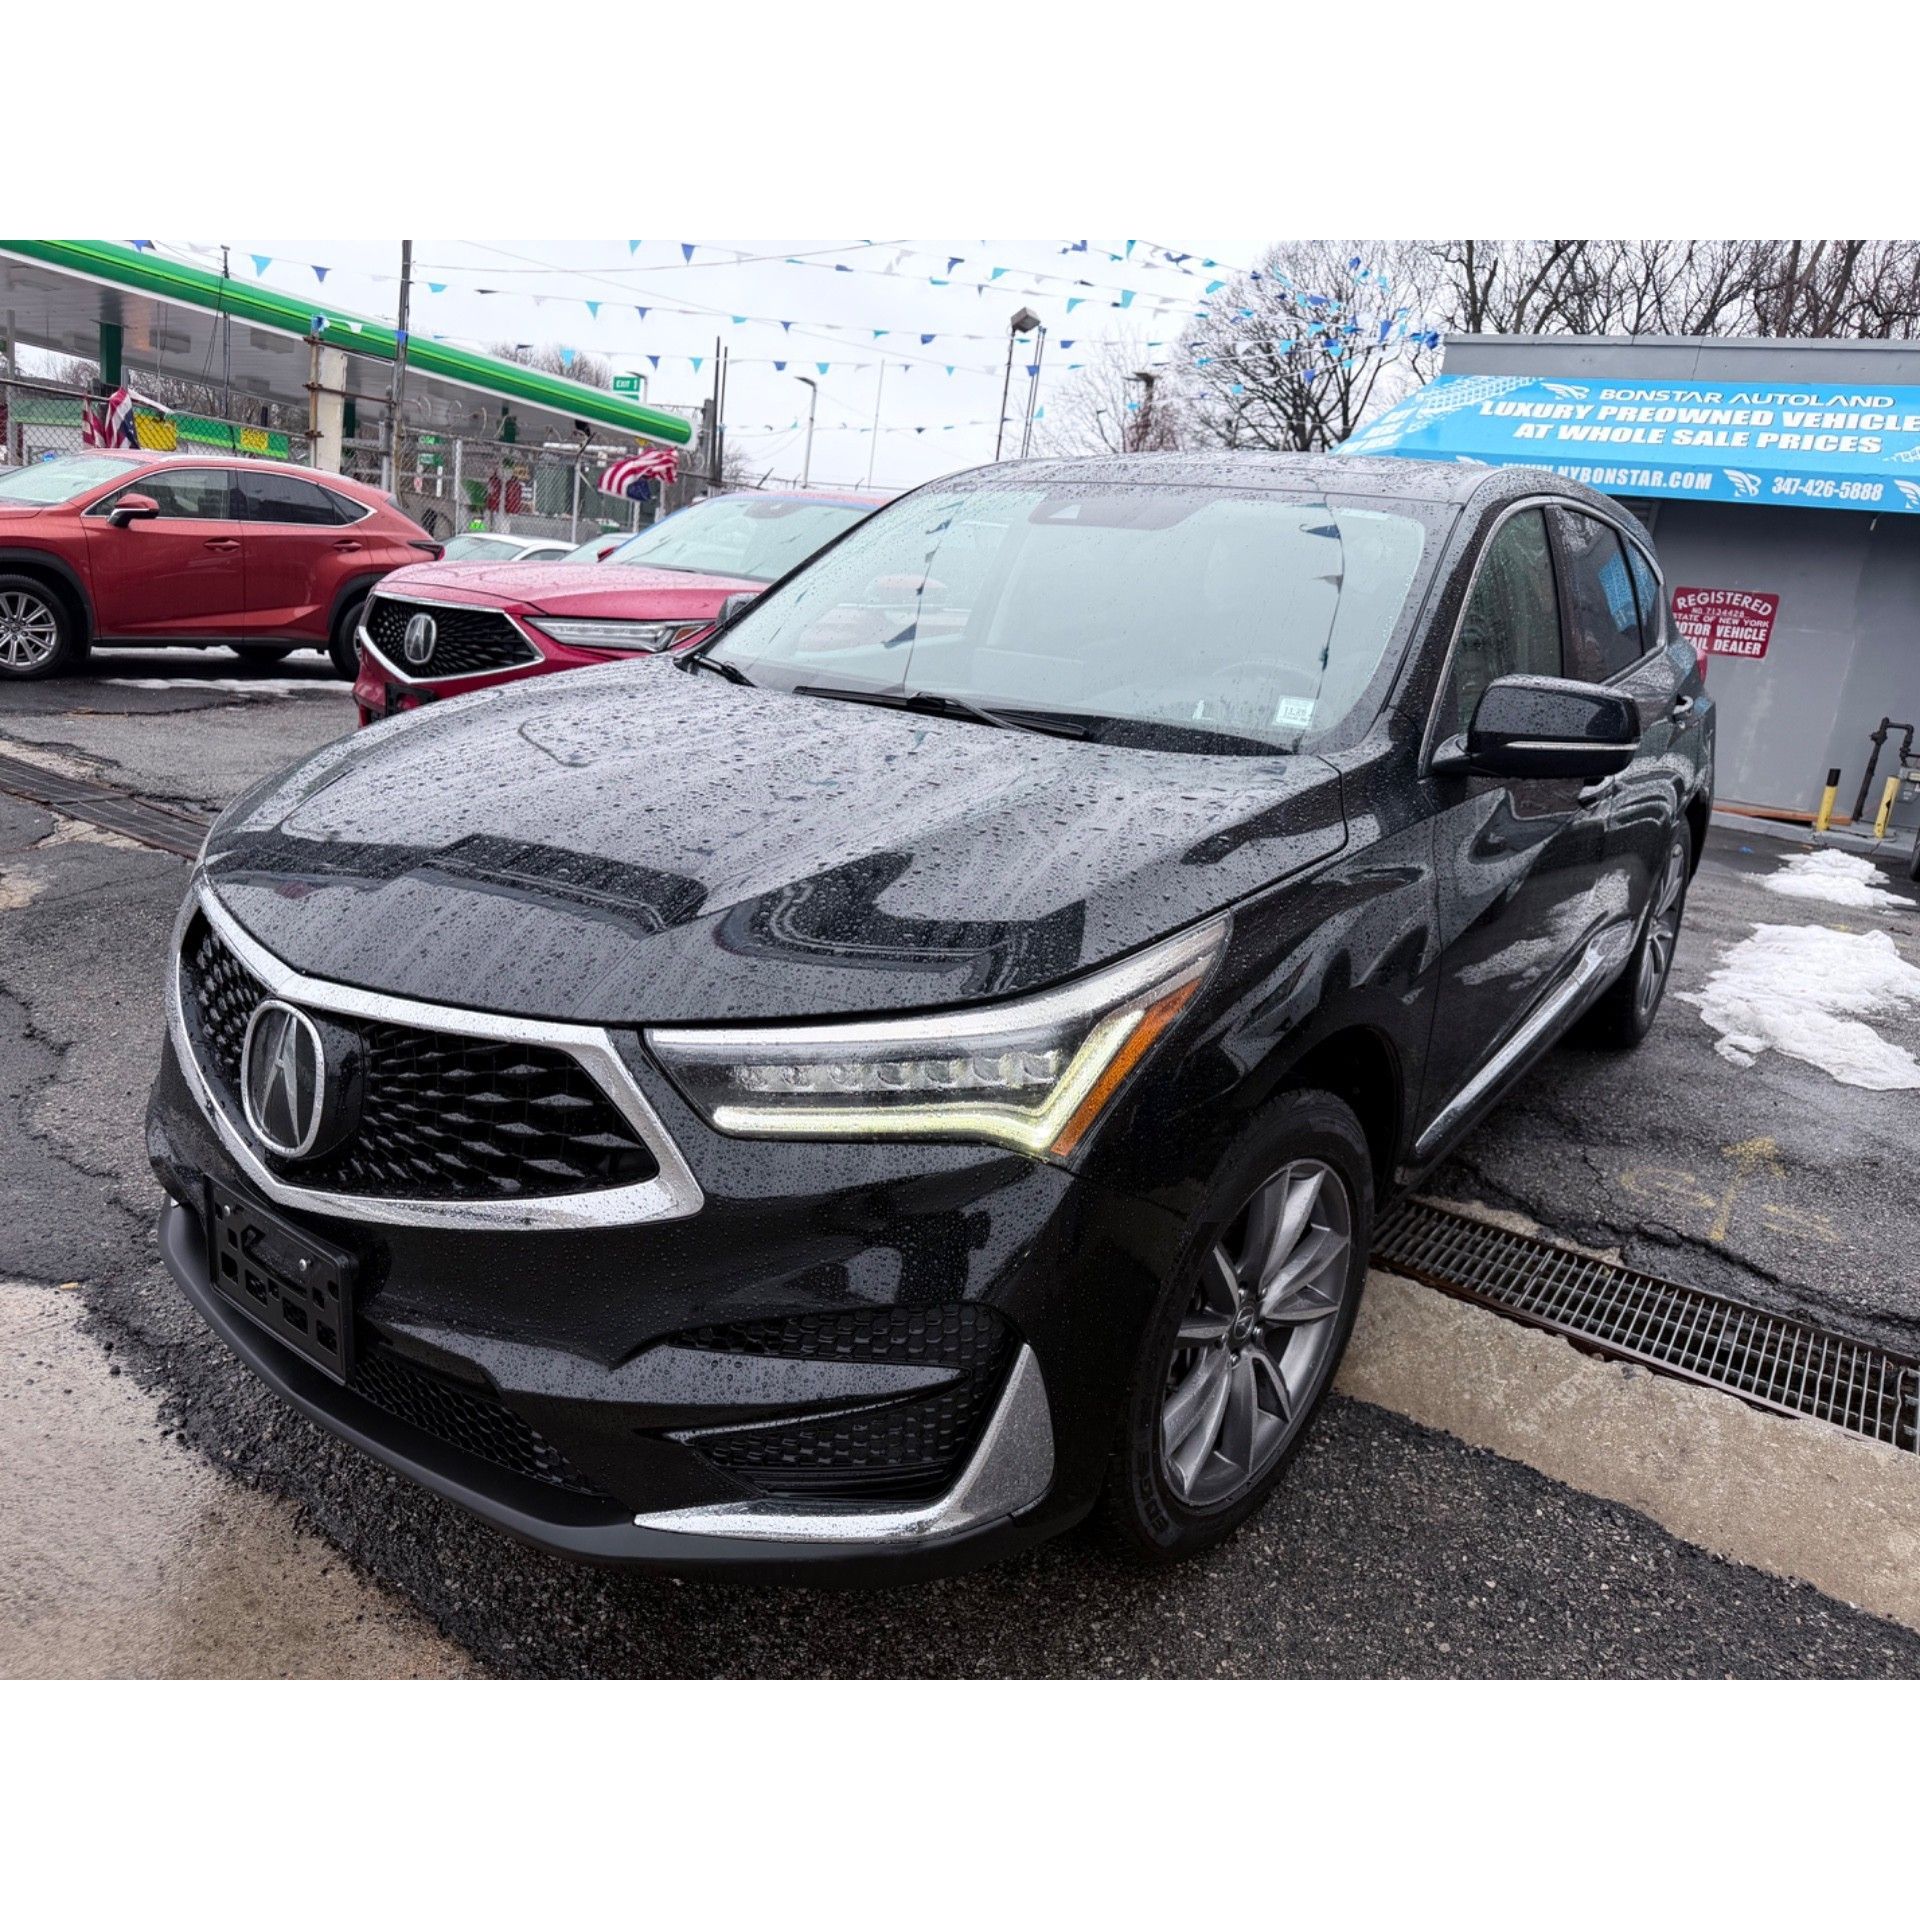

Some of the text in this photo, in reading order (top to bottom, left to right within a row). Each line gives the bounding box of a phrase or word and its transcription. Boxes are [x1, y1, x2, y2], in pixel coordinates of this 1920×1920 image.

[1600, 388, 1896, 408] BONSTAR AUTOLAND
[1479, 400, 1920, 432] LUXURY PREOWNED VEHICLE
[1512, 422, 1883, 454] AT WHOLE SALE PRICES
[1502, 462, 1885, 501] NYBONSTAR.COM 347-426-5888
[1677, 591, 1772, 615] REGISTERED
[1703, 615, 1717, 623] OF
[1719, 616, 1740, 625] NEW
[1743, 617, 1770, 629] YORK
[1716, 625, 1768, 641] VEHICLE
[1713, 638, 1762, 655] DEALER
